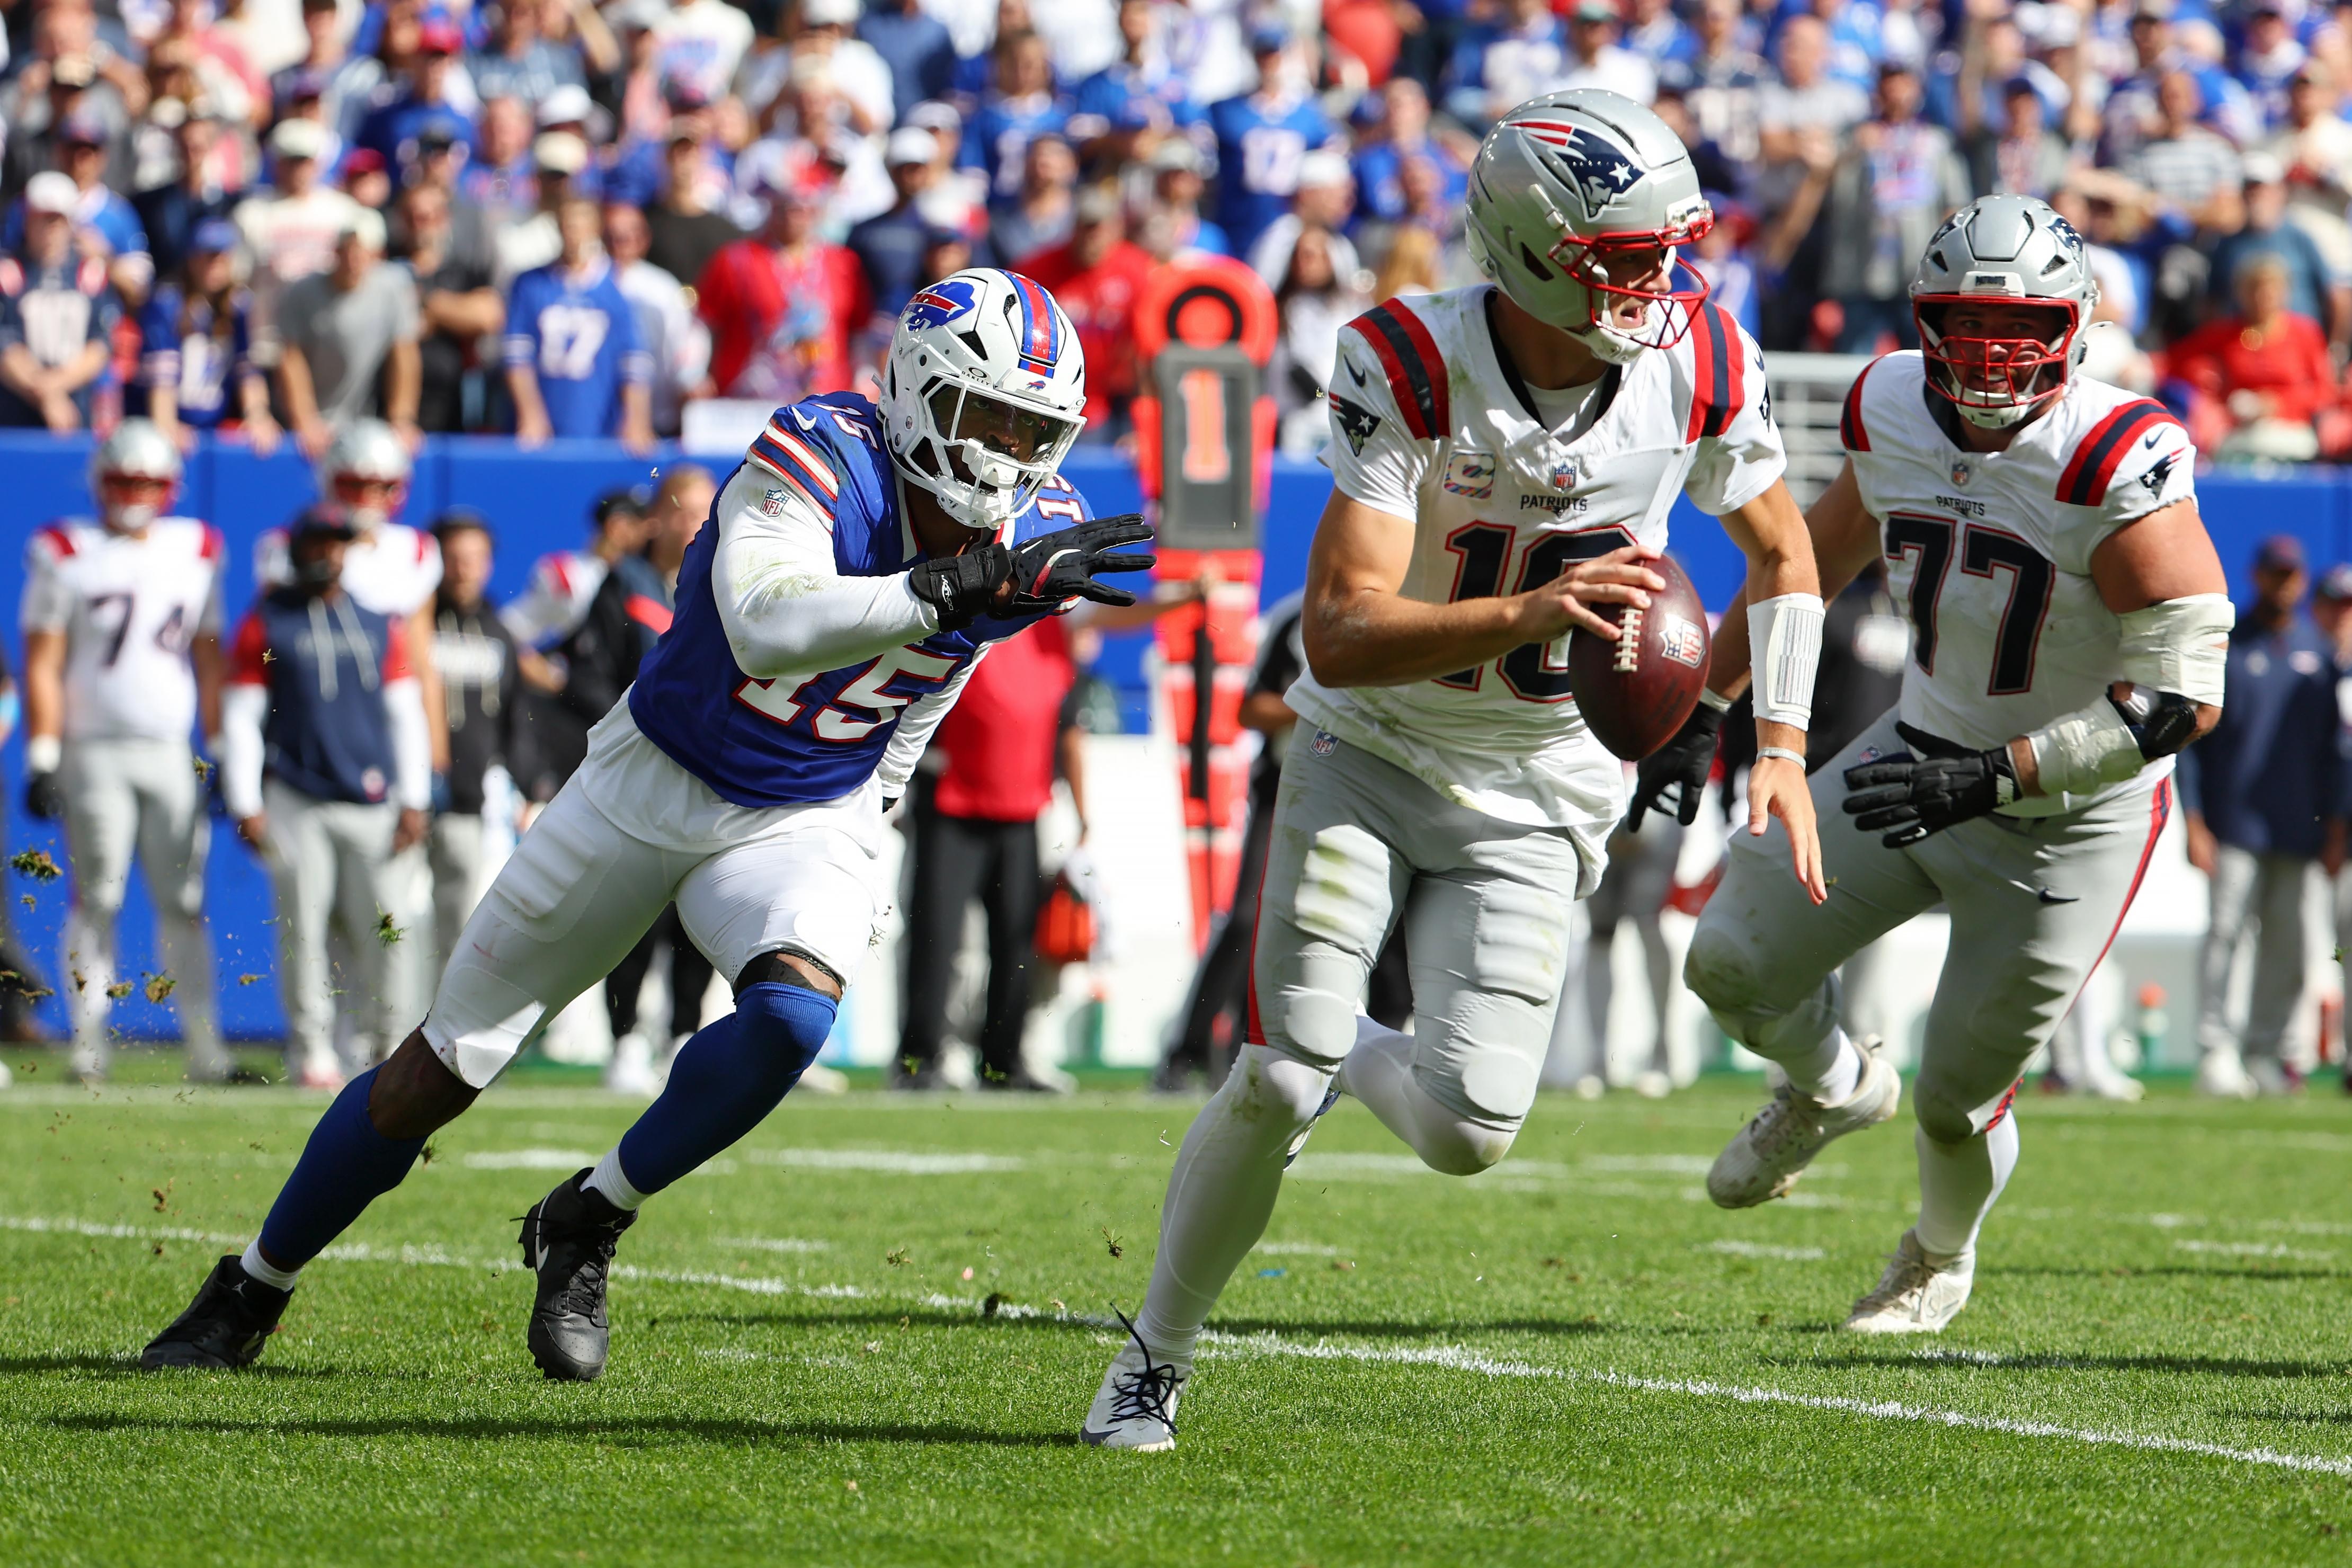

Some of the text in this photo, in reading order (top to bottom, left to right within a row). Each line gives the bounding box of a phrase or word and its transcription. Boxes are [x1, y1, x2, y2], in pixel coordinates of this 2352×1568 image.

[961, 371, 990, 386] OAKLEY
[1177, 368, 1232, 484] 1
[1555, 477, 1573, 487] NFL
[762, 499, 780, 515] NFL
[1520, 494, 1589, 511] PATRIOTS
[1936, 495, 1985, 516] PATRIOTS
[1886, 511, 2056, 696] 77
[1682, 629, 1701, 662] NFL
[1314, 739, 1331, 753] NFL
